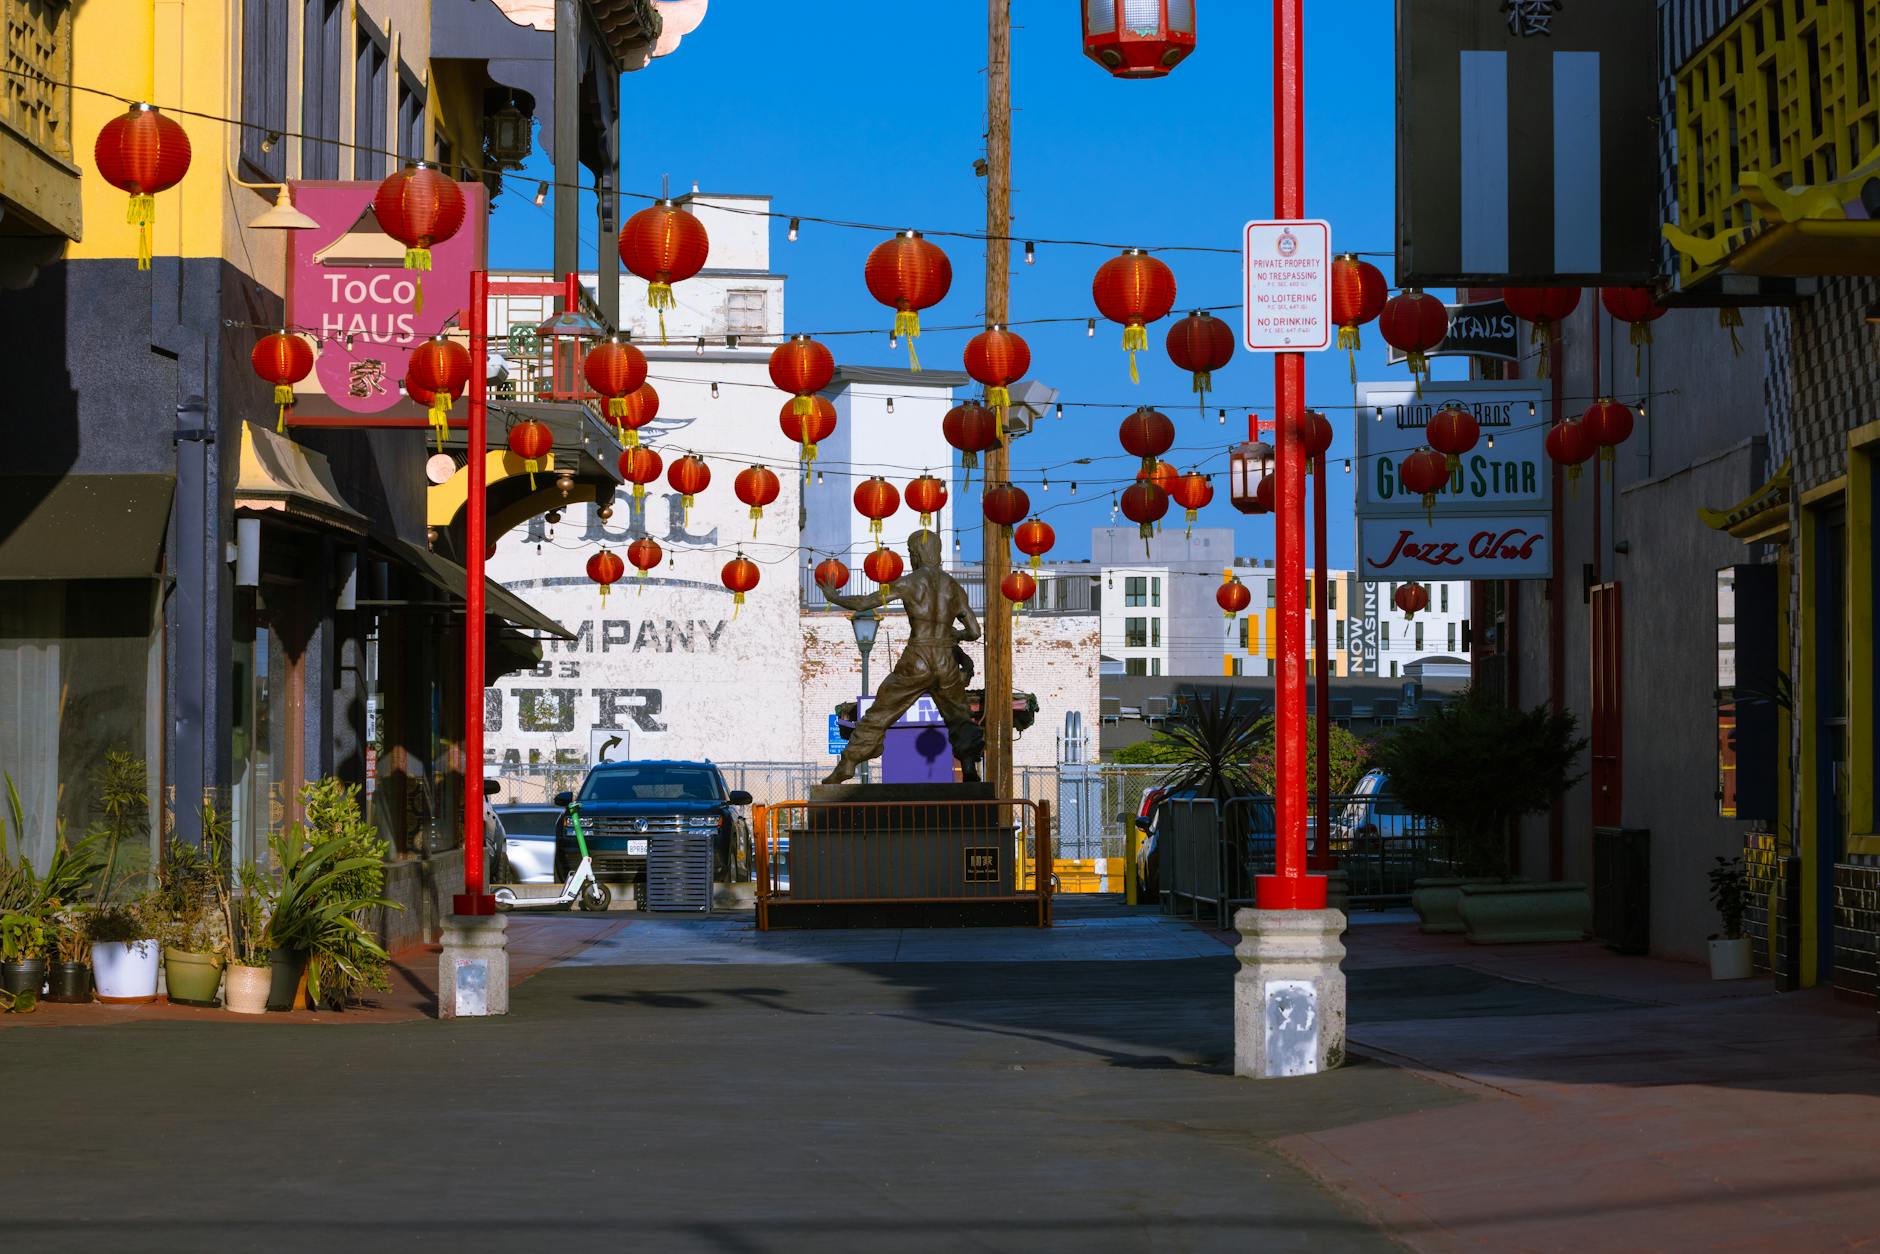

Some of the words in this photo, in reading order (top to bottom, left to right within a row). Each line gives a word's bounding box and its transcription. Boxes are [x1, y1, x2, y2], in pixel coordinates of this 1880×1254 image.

[1254, 259, 1282, 268] PRIVATE
[1284, 259, 1320, 268] PROPERTY
[1257, 272, 1268, 280] NO
[1270, 272, 1317, 280] TRESPASSING
[323, 273, 416, 304] ToCo
[1257, 294, 1269, 303] NO
[1272, 294, 1317, 303] LOITERING
[322, 313, 415, 343] HAUS
[1257, 318, 1270, 326] NO
[1273, 317, 1317, 326] DRINKING
[1470, 455, 1536, 498] STAR
[1367, 531, 1464, 568] Jazz
[1468, 528, 1544, 560] Club
[1364, 582, 1377, 672] LEASING
[1350, 616, 1363, 672] NOW
